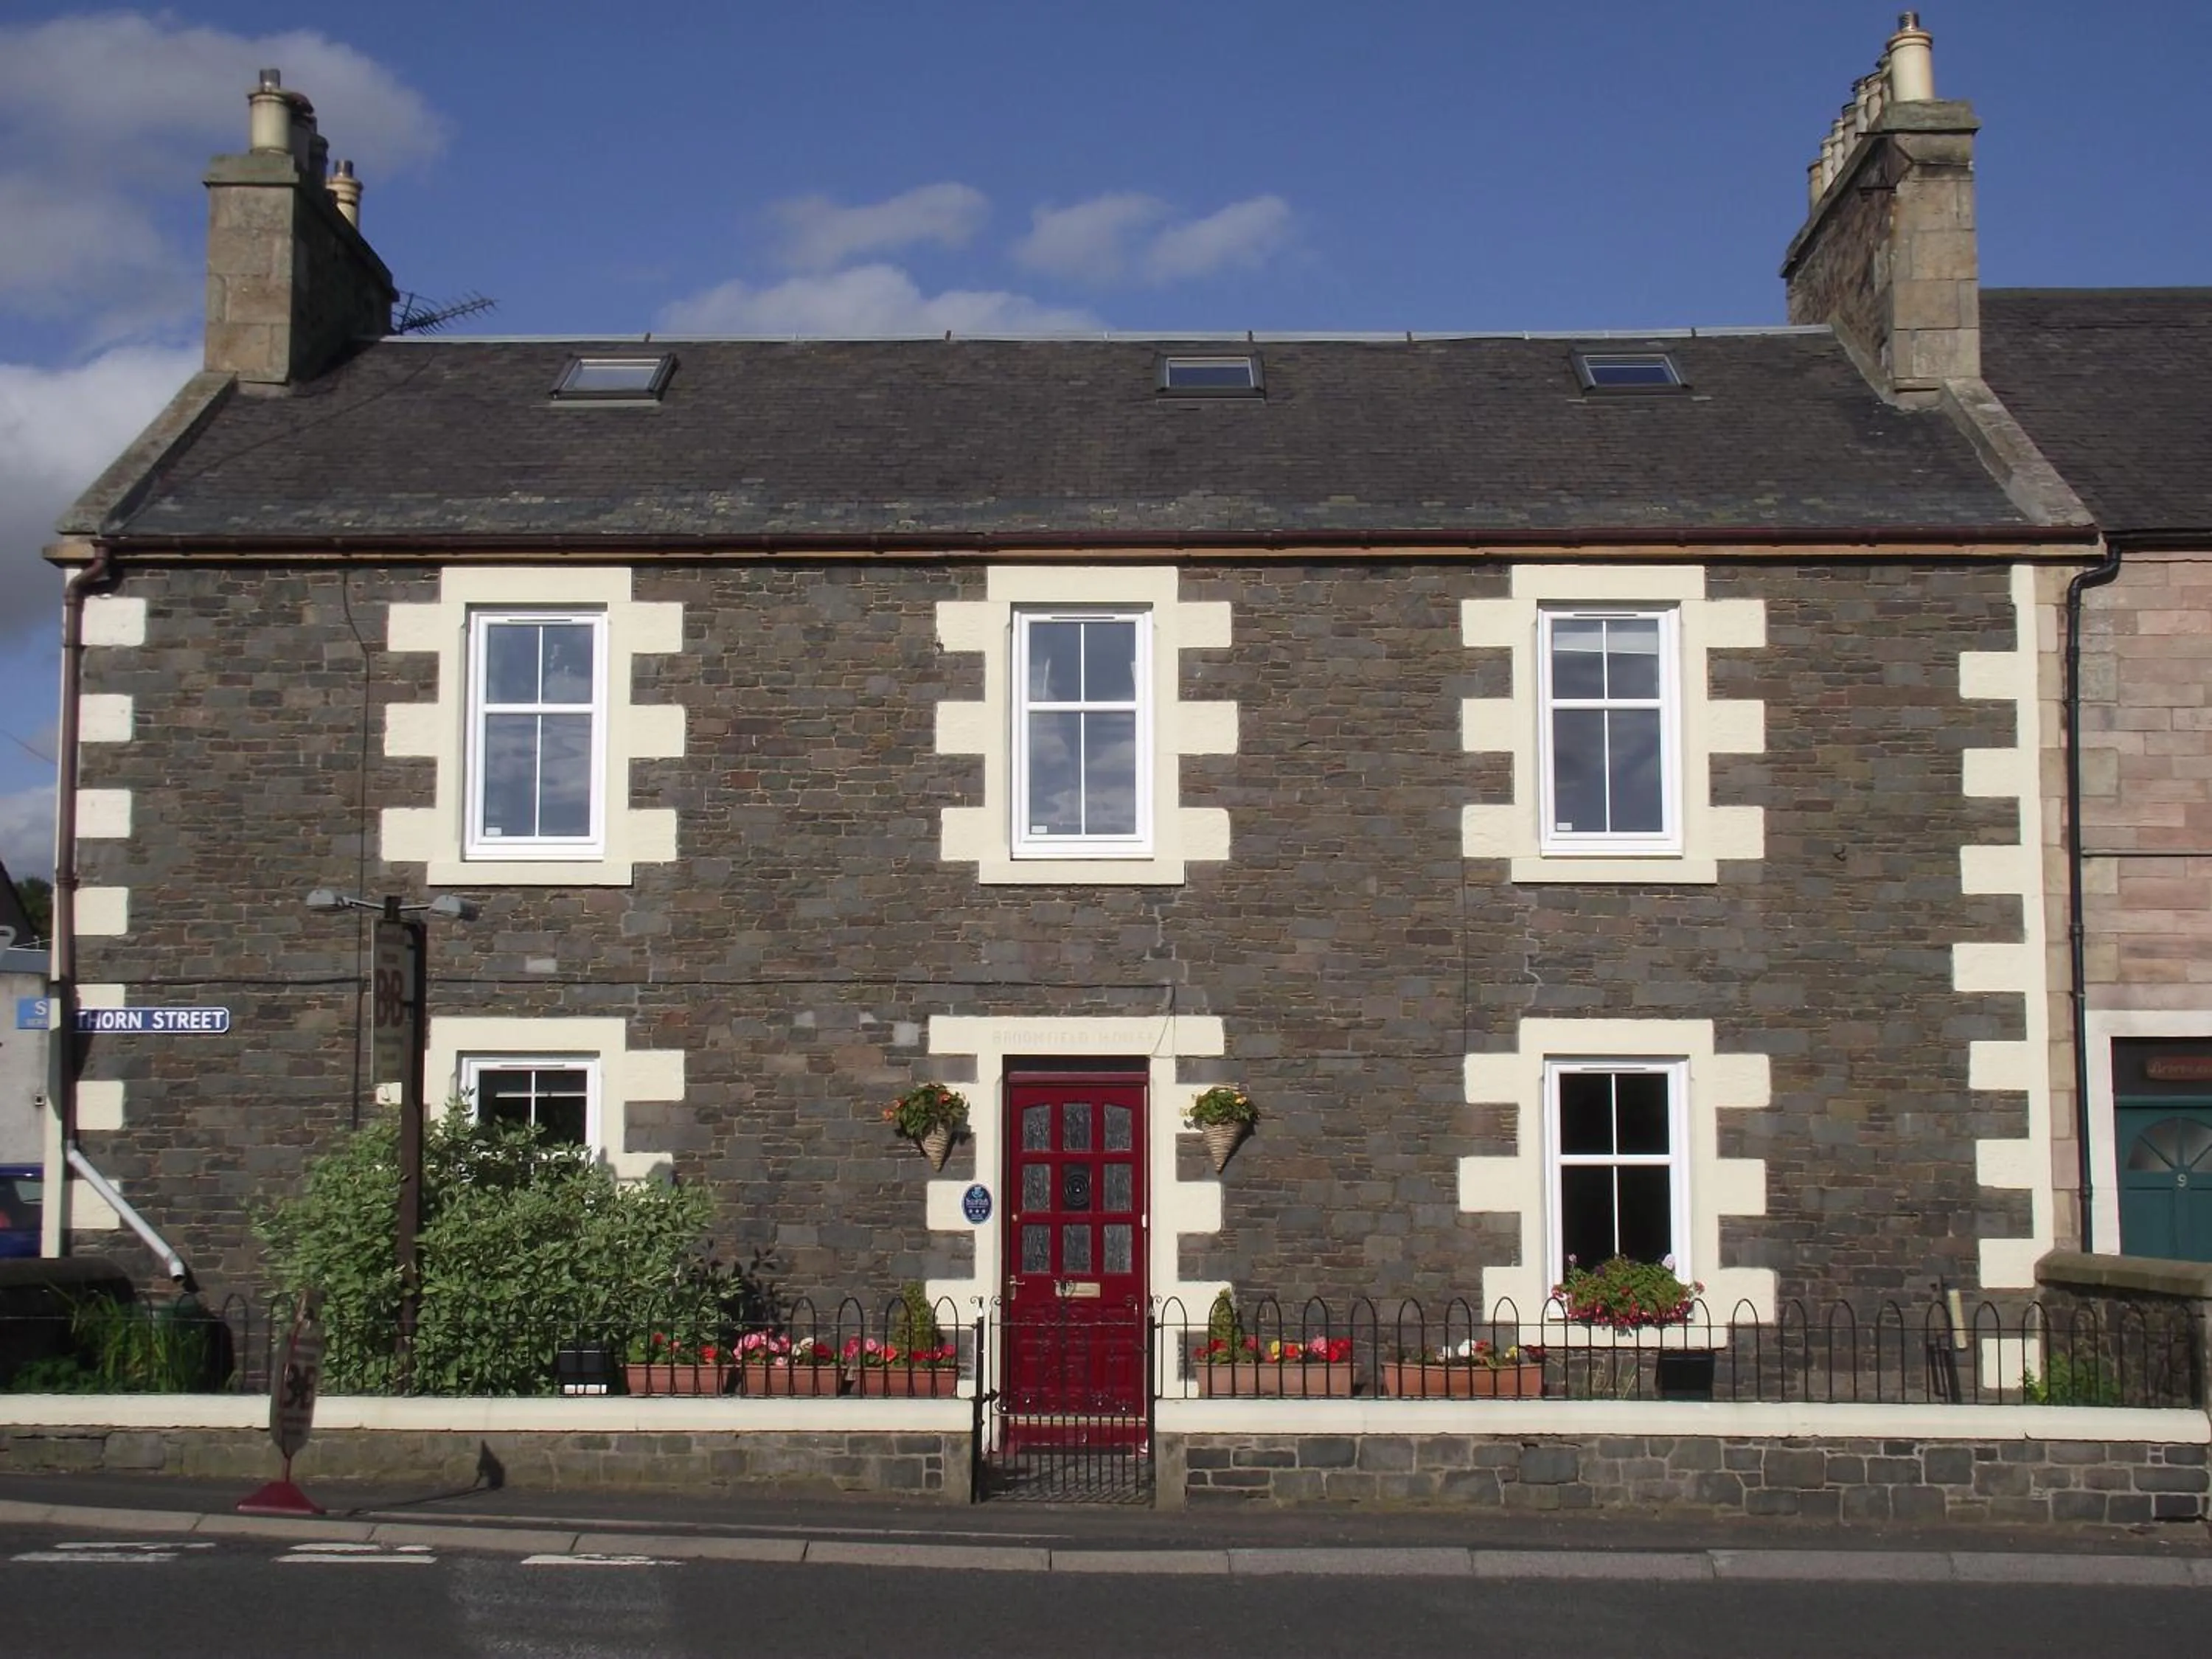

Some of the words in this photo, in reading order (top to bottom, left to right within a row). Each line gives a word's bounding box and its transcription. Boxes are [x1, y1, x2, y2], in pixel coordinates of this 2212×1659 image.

[77, 1011, 142, 1029] THORN
[152, 1011, 224, 1029] STREET
[2177, 1173, 2188, 1188] 9
